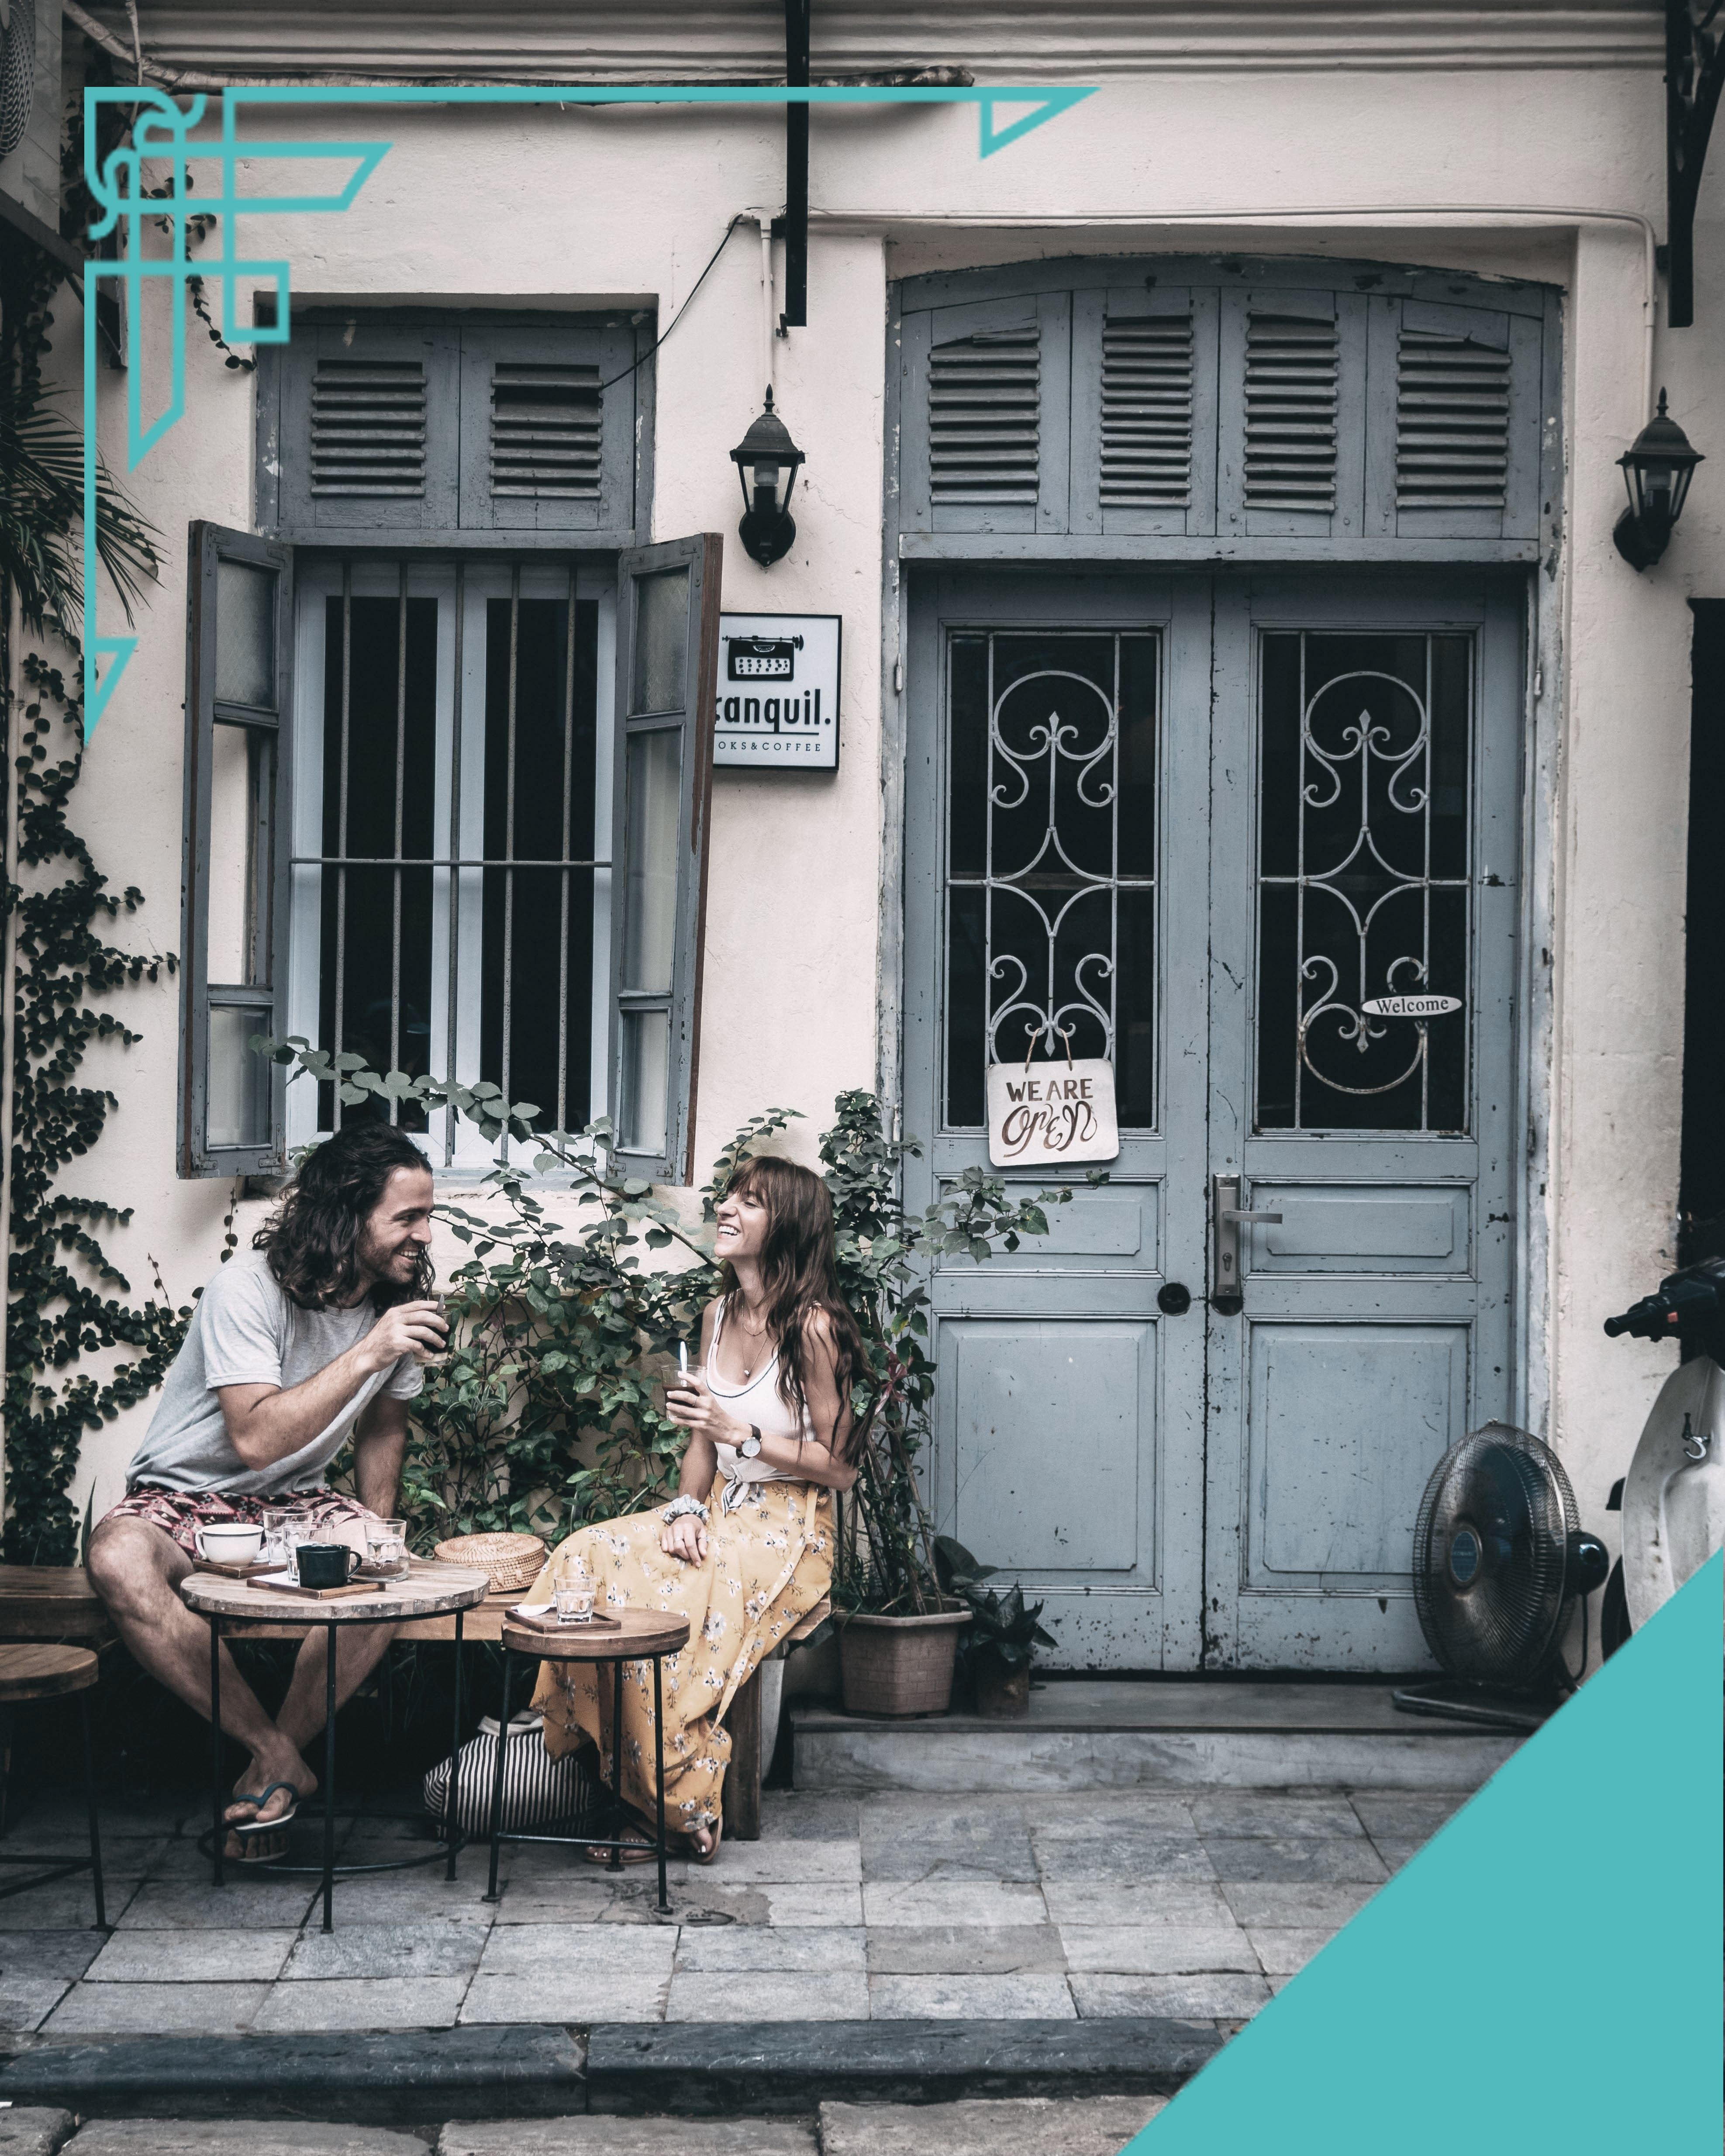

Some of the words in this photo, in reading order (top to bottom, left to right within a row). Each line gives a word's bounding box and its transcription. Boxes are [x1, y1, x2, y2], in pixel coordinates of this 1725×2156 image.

[1376, 998, 1449, 1014] Welcome
[1006, 1081, 1043, 1102] WE
[1045, 1078, 1094, 1101] ARE
